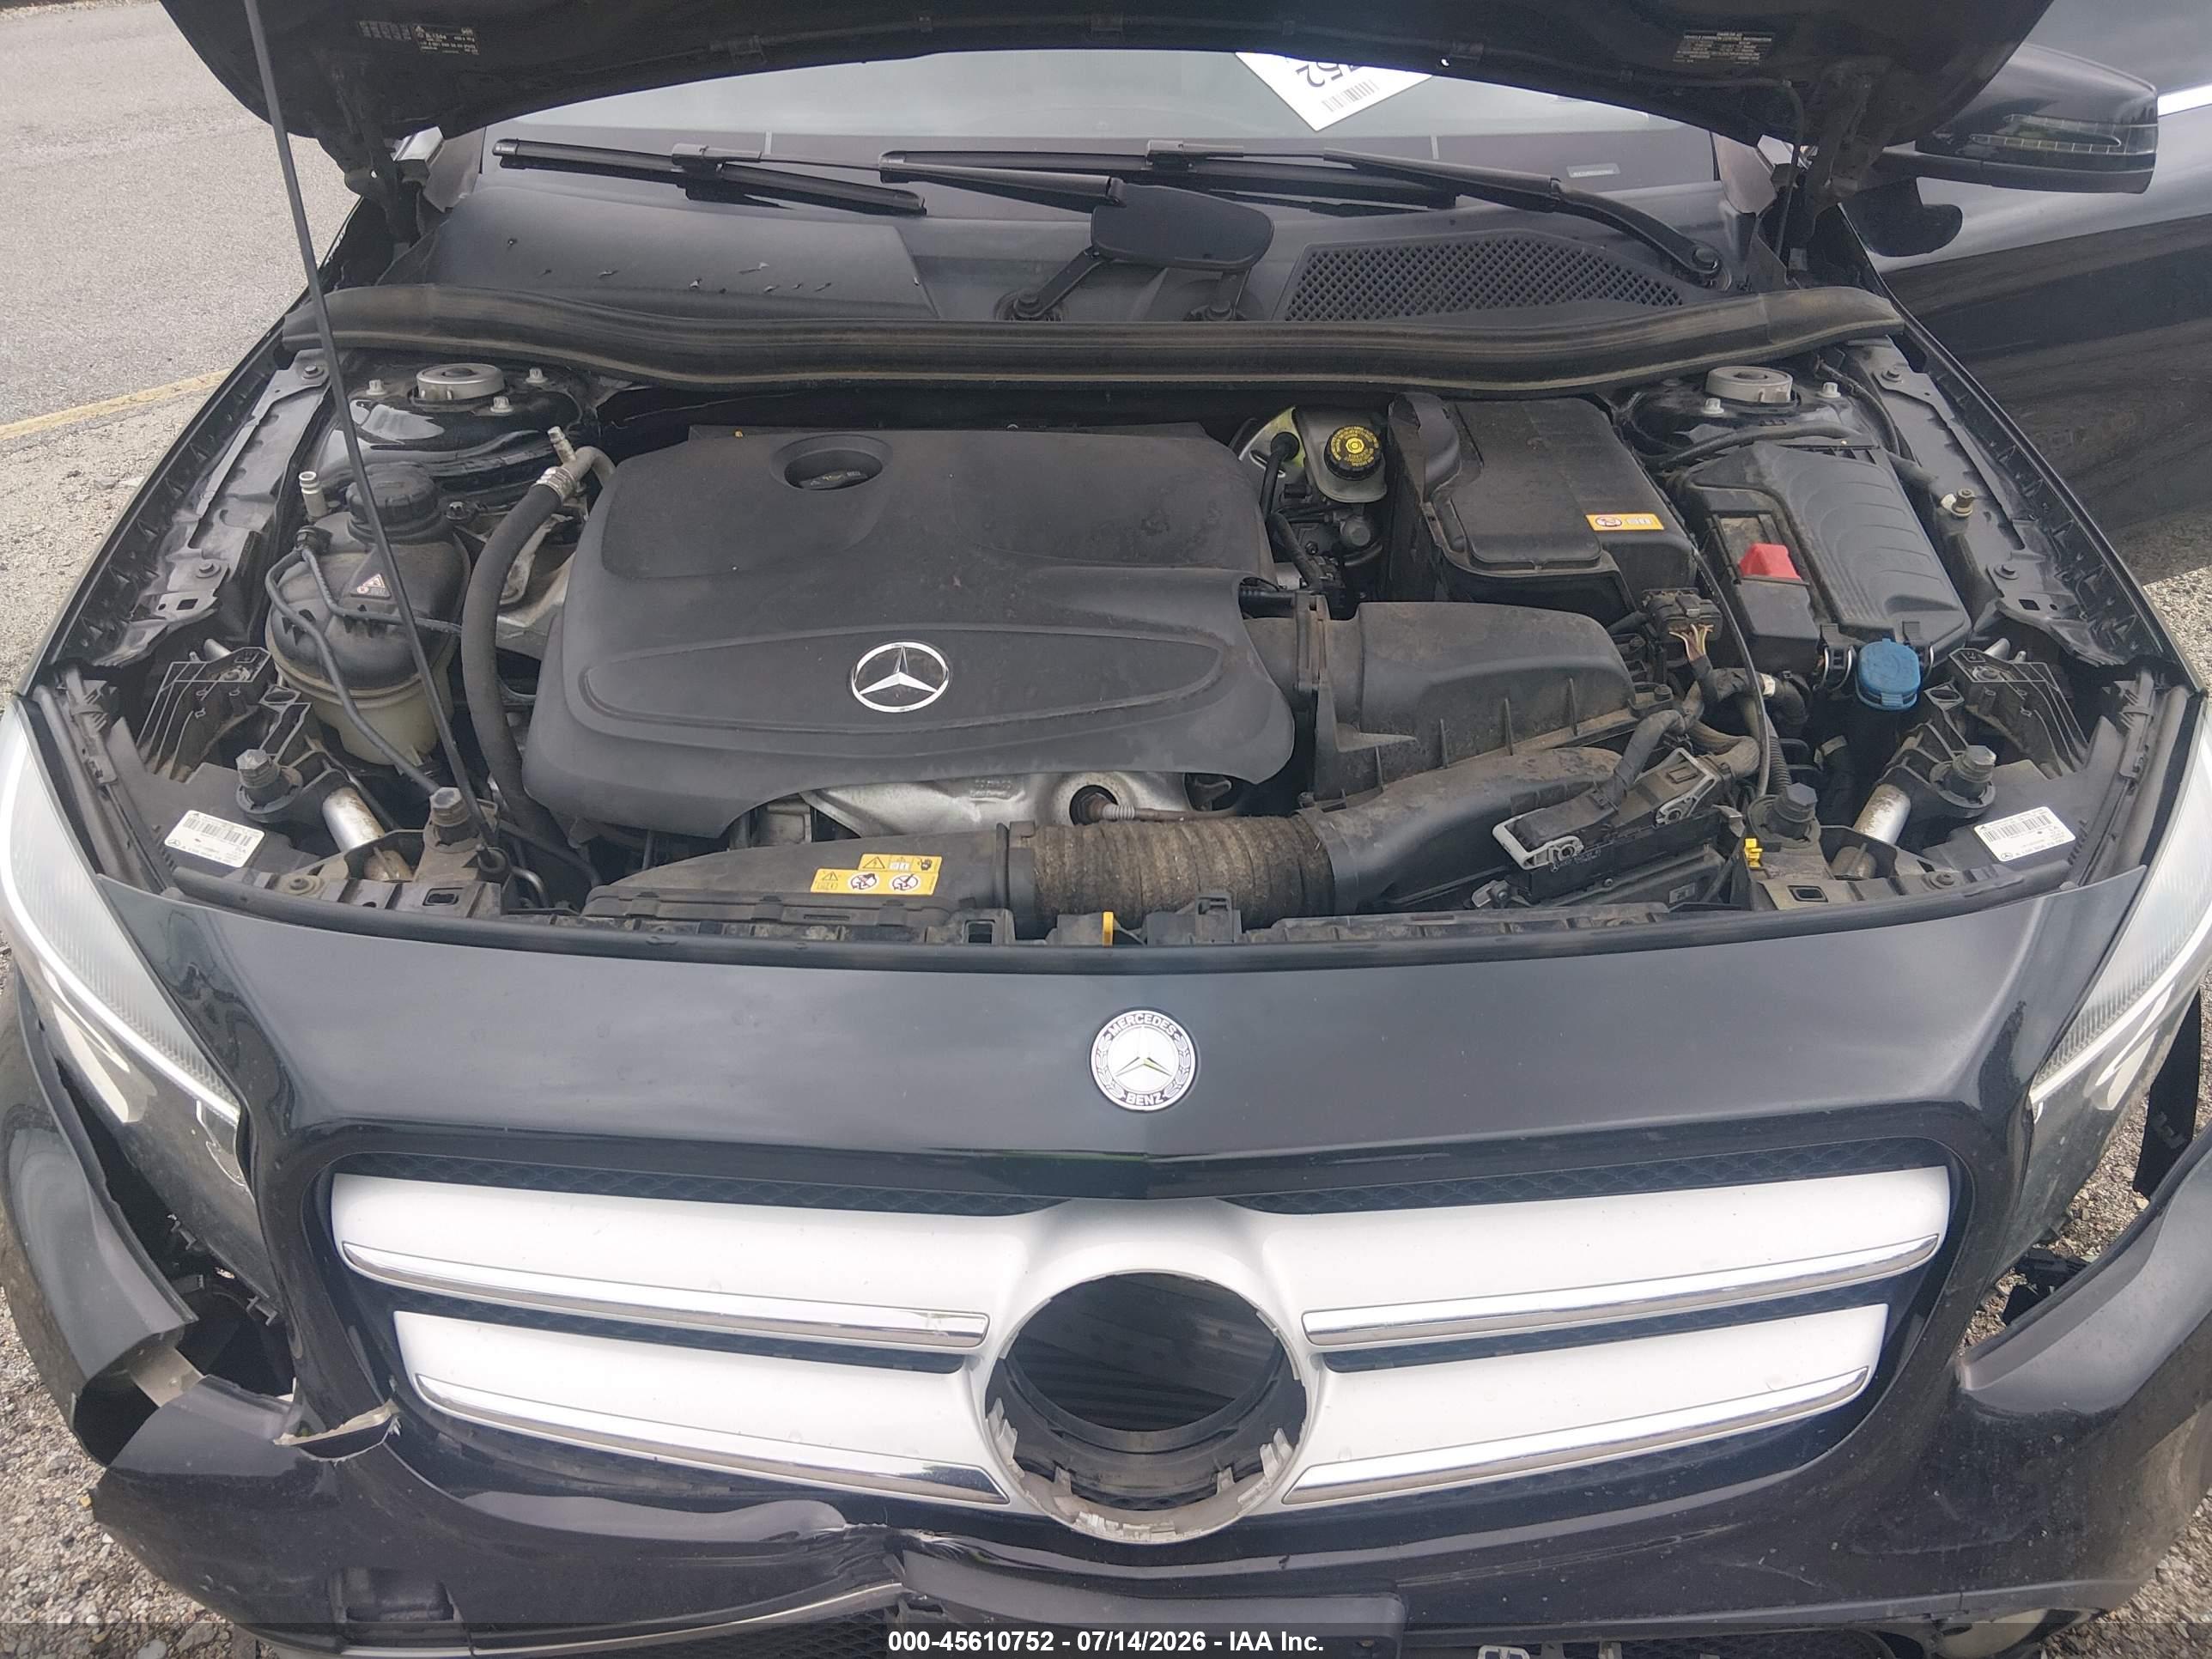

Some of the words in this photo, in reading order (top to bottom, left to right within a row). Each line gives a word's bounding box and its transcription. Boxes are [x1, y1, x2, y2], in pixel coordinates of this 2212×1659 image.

[1295, 61, 1363, 88] 52
[1109, 1013, 1176, 1036] MERCEDES
[1125, 1091, 1164, 1106] BENZ
